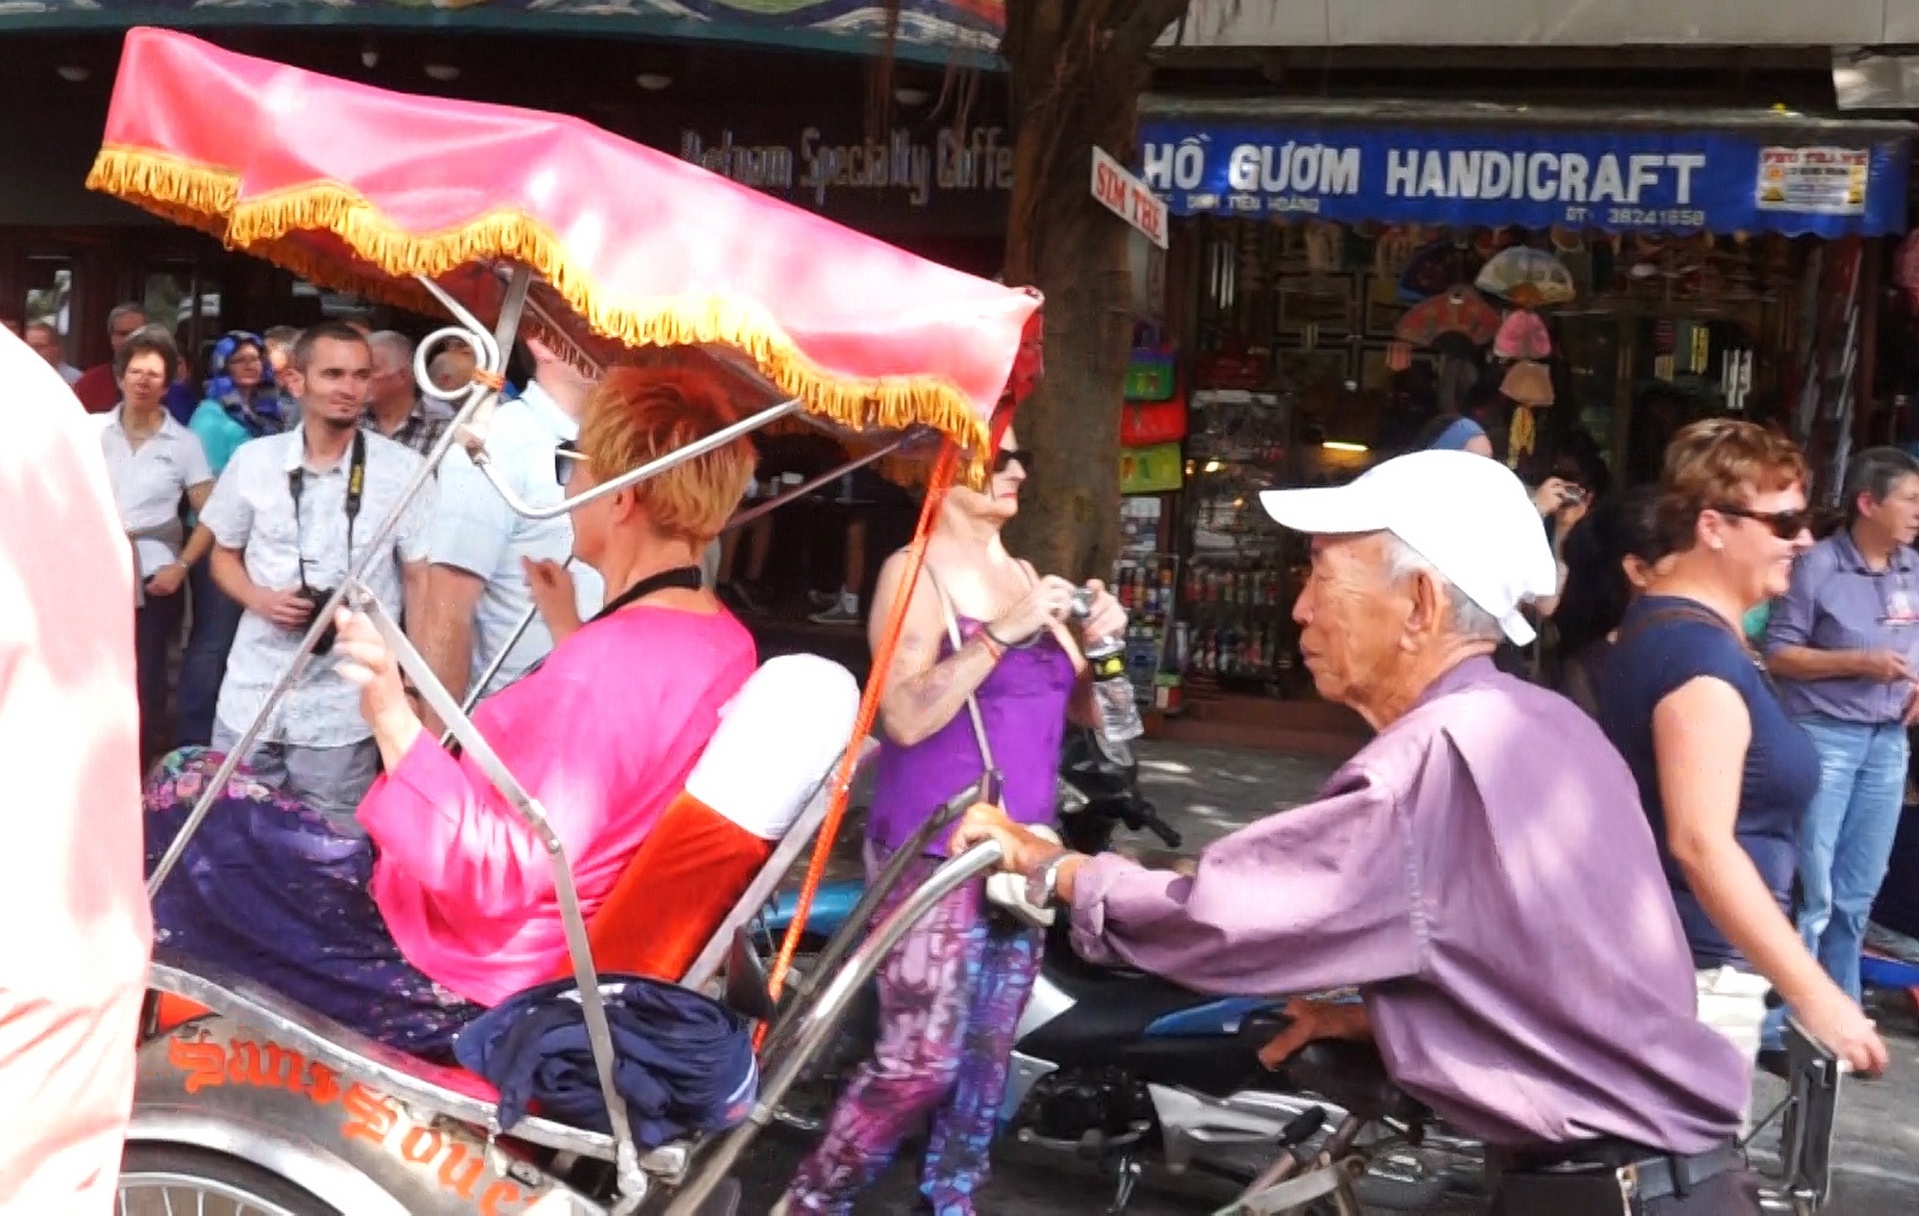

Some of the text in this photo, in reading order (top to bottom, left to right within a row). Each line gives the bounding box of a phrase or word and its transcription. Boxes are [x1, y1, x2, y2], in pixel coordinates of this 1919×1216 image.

[799, 126, 930, 206] Specialty
[1097, 161, 1127, 215] SIM
[1143, 133, 1706, 205] HỒ GƯƠM HANDICRAFT
